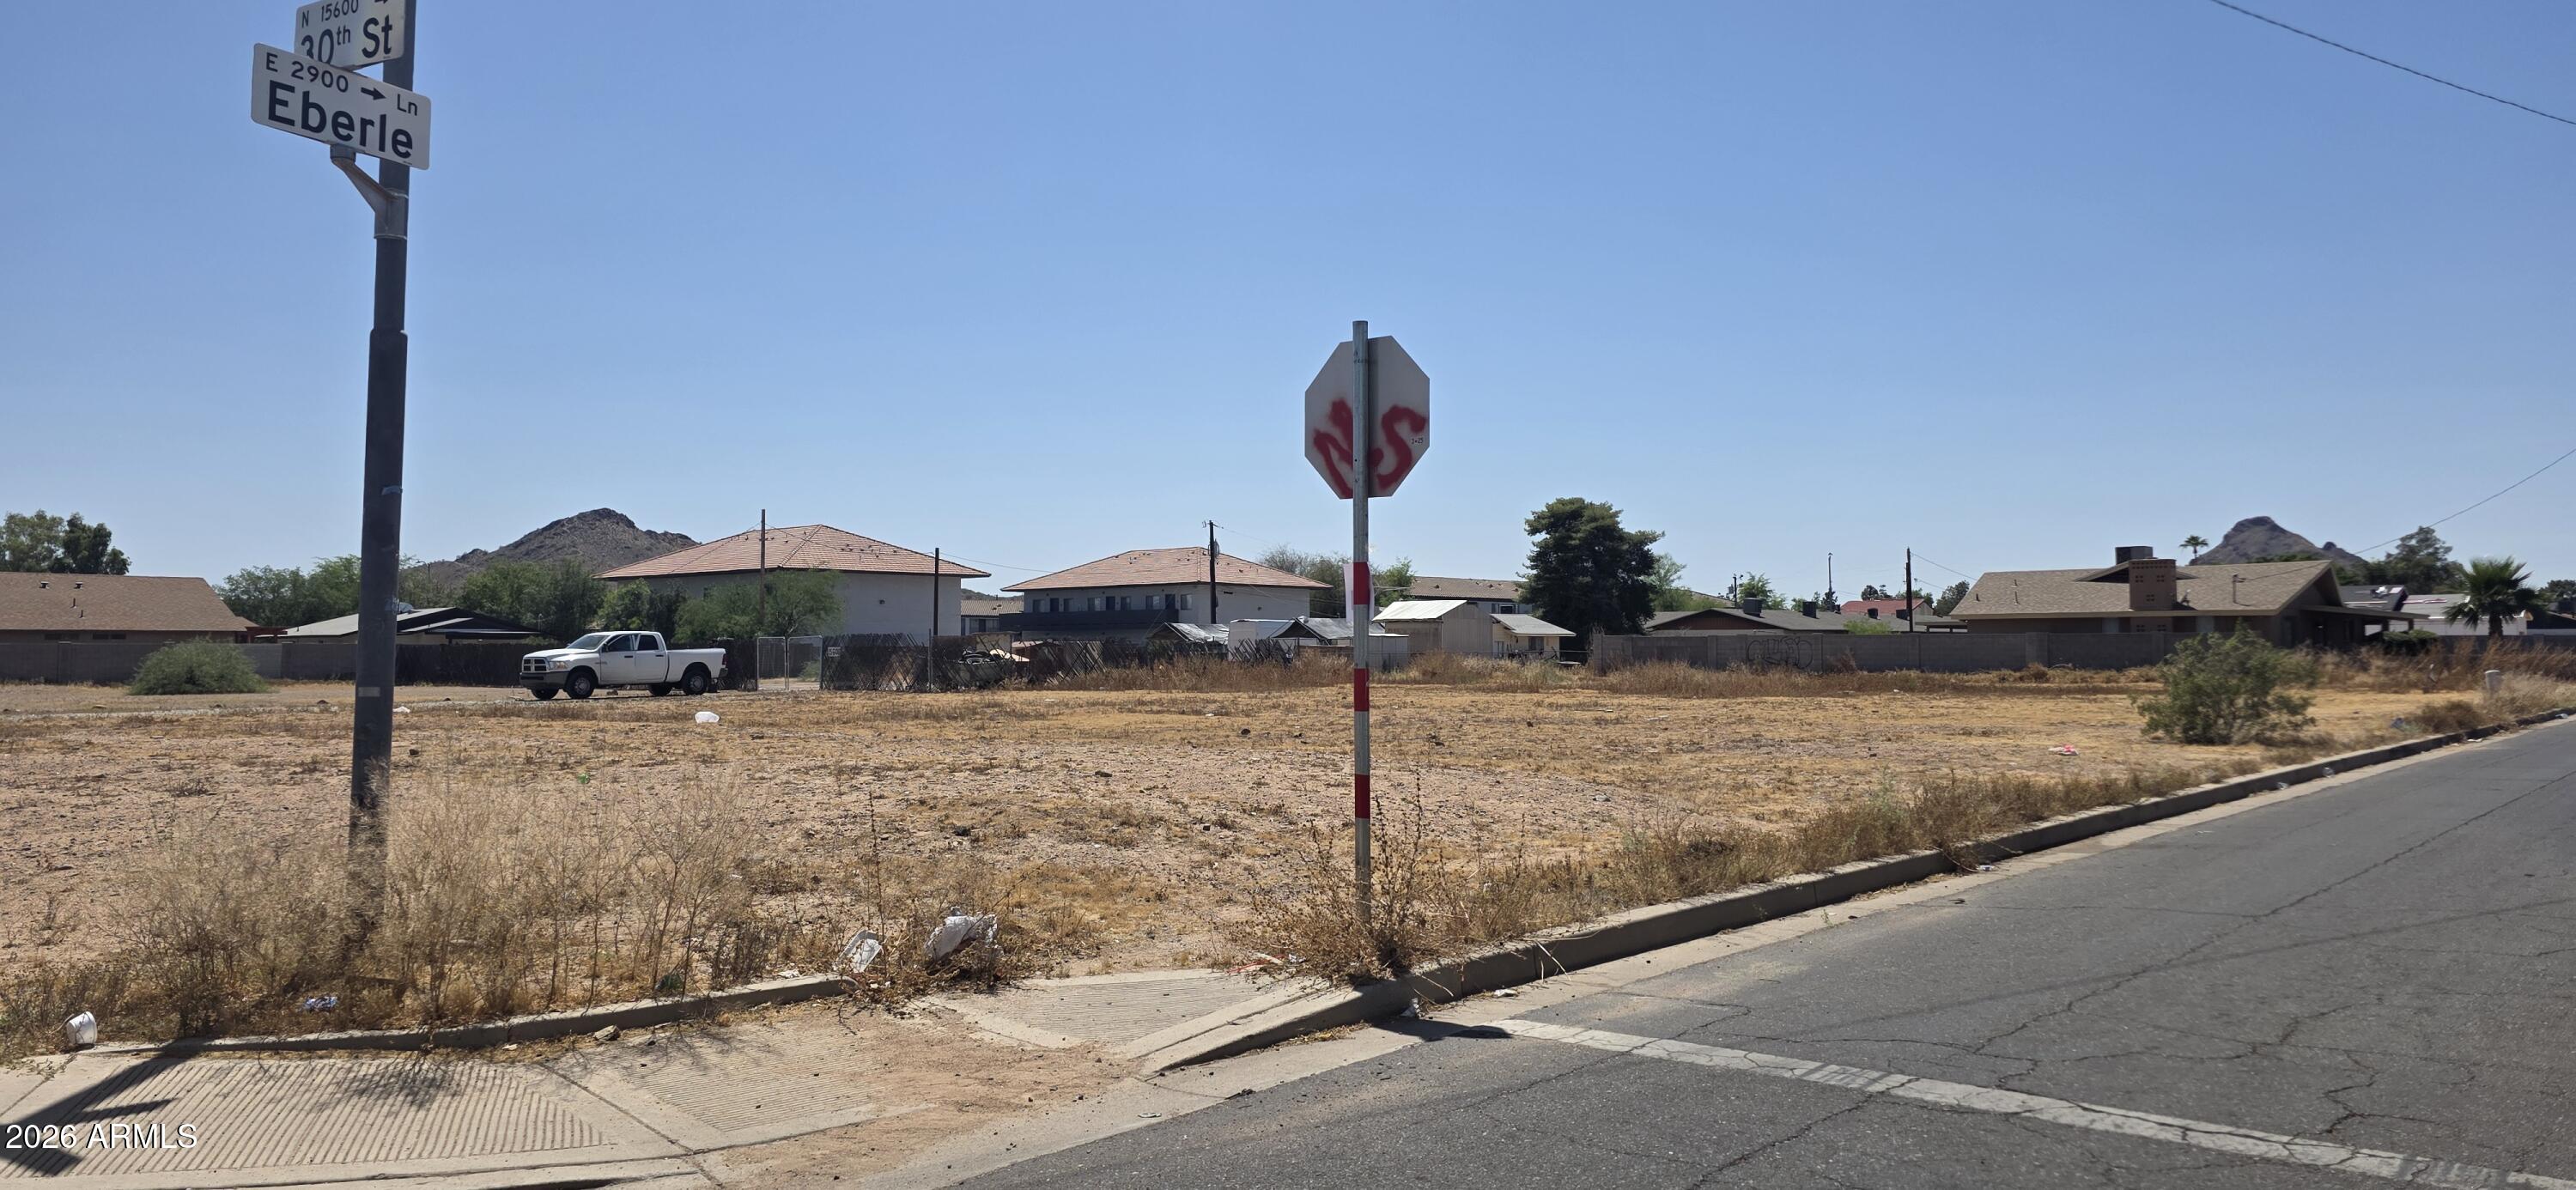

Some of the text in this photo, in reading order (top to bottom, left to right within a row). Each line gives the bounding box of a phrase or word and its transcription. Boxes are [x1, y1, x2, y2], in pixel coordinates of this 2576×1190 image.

[301, 0, 359, 28] N 15600
[301, 14, 393, 65] 30th St
[265, 52, 418, 117] E 2900 Ln
[268, 79, 413, 160] Eberle
